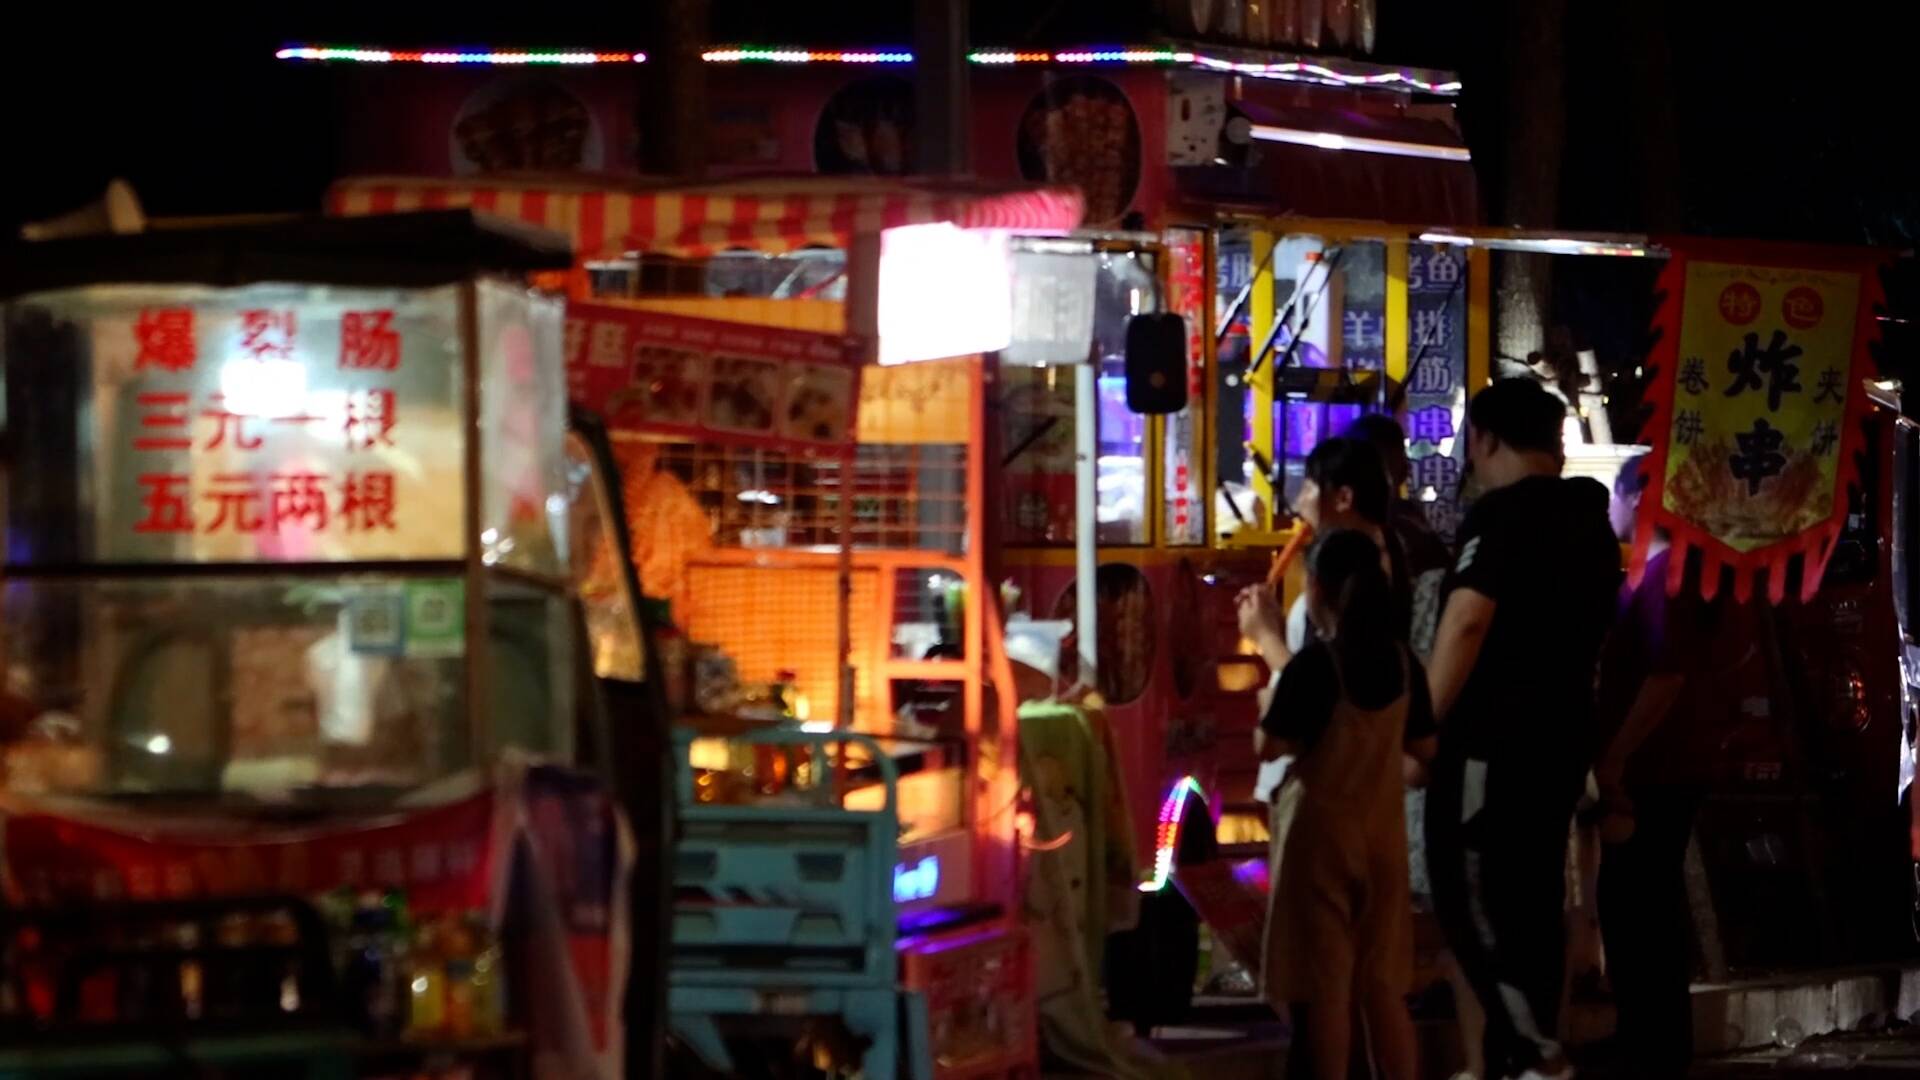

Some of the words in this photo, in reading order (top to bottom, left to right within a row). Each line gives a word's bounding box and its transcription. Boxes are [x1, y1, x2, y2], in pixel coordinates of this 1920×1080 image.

[134, 309, 402, 371] 爆裂肠
[134, 390, 397, 451] 三元一根
[1675, 357, 1711, 446] 卷饼
[1724, 329, 1804, 497] 炸串
[1812, 367, 1845, 457] 夹饼
[134, 472, 399, 535] 五元两根
